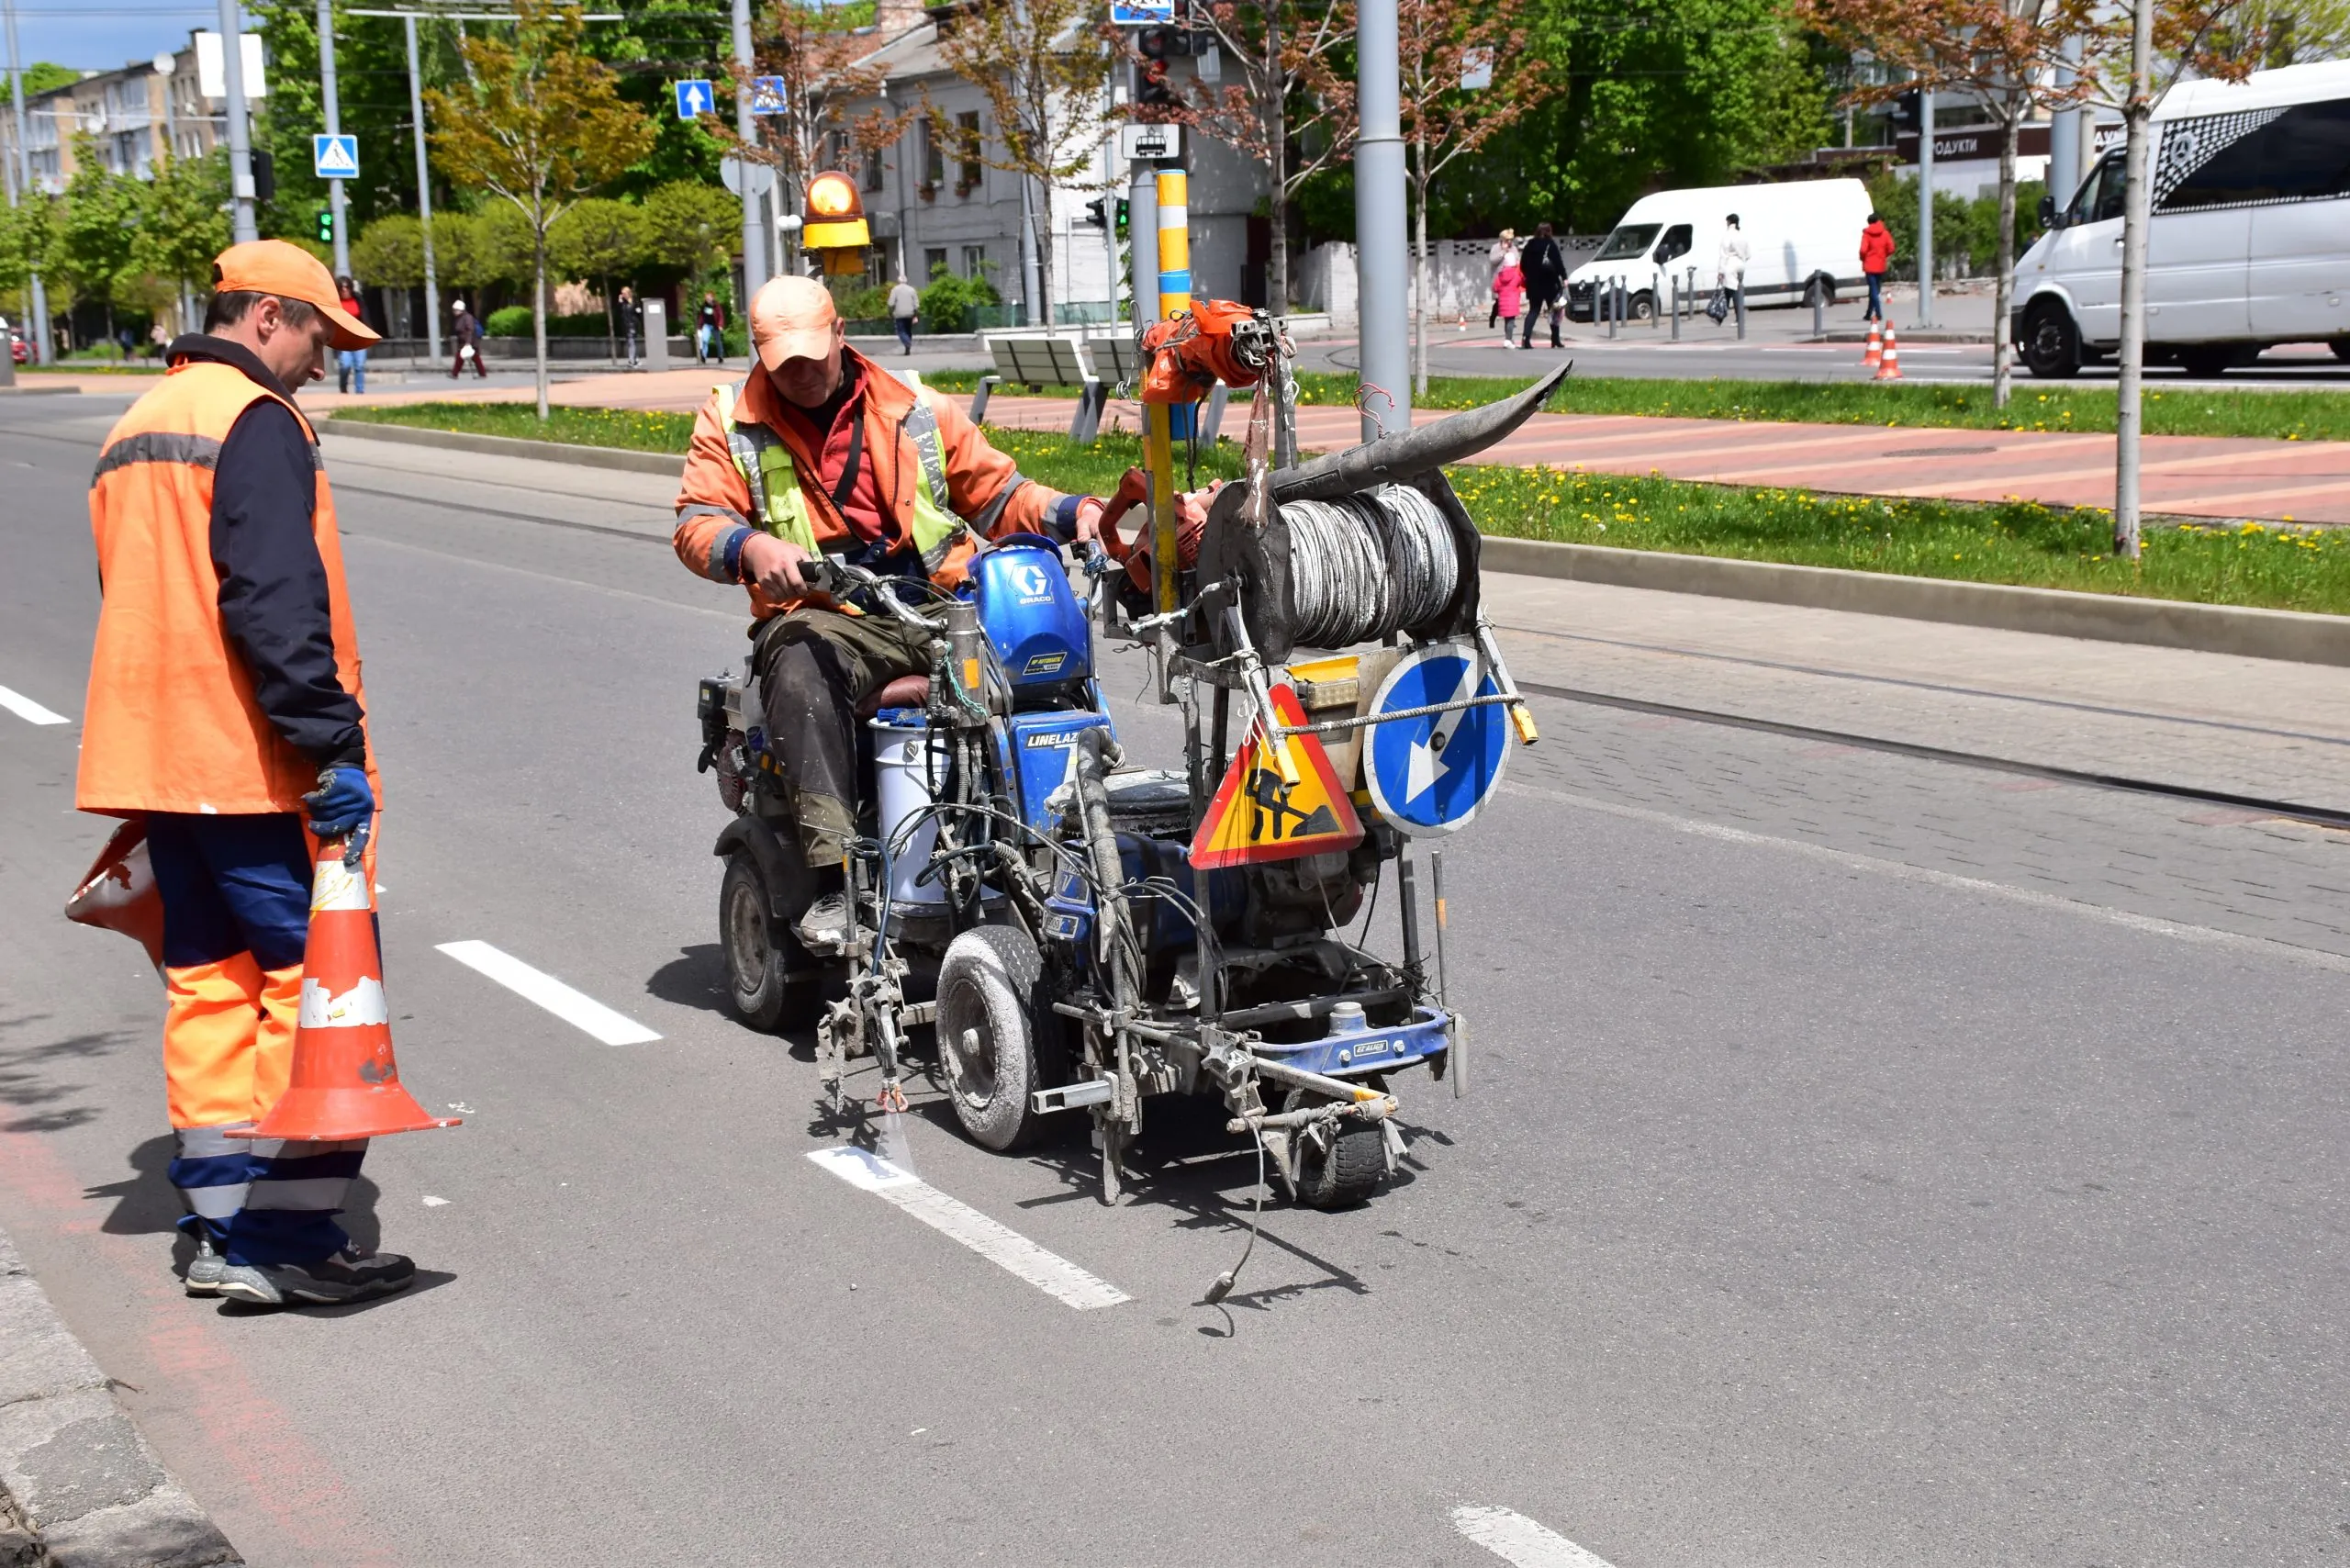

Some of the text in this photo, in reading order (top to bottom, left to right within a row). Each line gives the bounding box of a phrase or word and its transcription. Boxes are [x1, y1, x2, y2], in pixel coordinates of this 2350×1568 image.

[1935, 139, 1977, 155] ОДУКТИ
[1020, 596, 1051, 604] GRACO
[1028, 733, 1078, 746] LINELAZ
